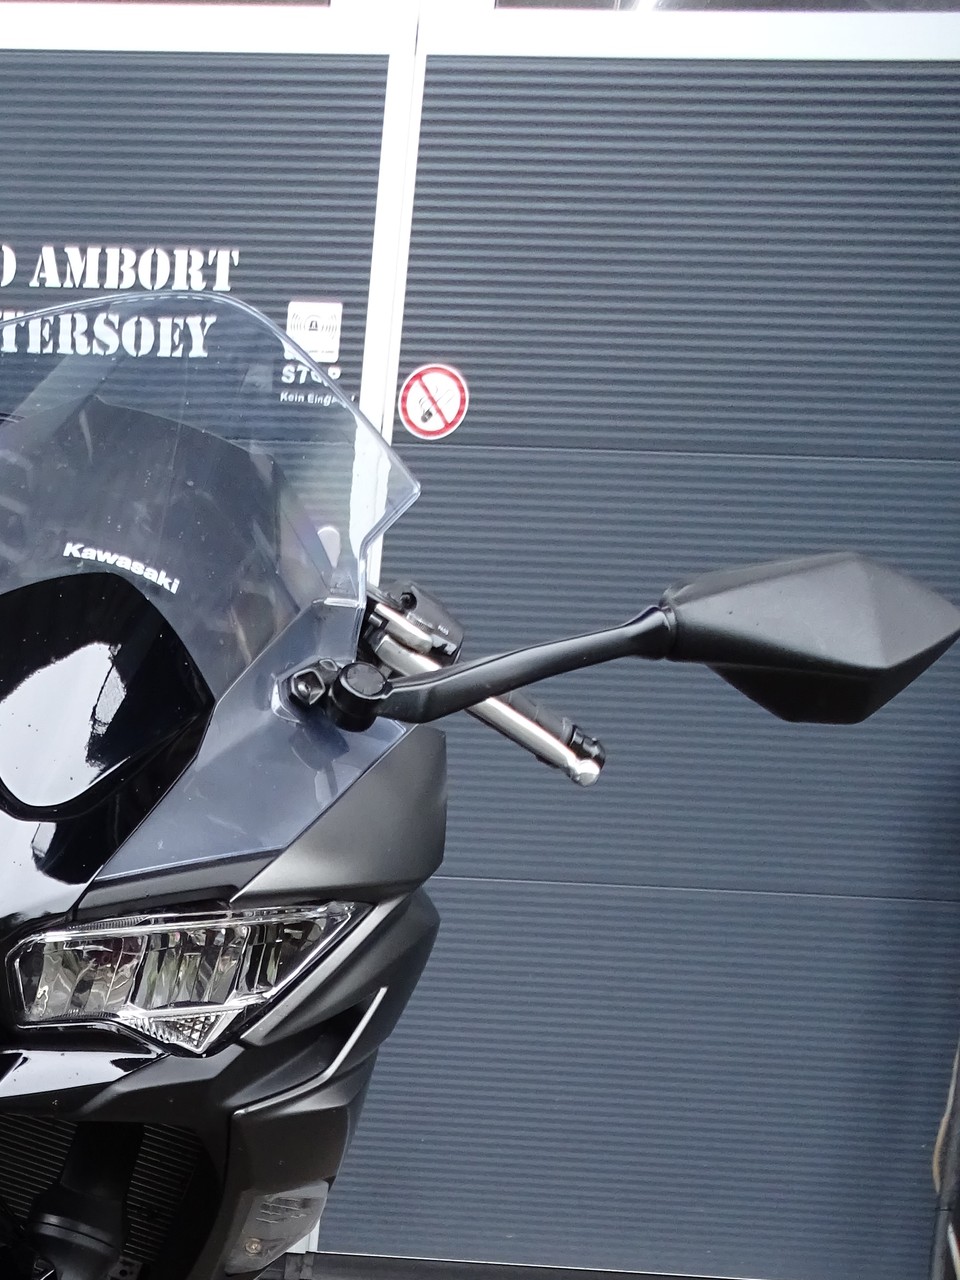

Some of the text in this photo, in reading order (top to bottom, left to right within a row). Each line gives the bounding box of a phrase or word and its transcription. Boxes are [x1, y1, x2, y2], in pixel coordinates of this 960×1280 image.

[29, 247, 240, 291] AMBORT
[280, 391, 305, 403] Kein
[63, 542, 180, 594] Kawasaki
